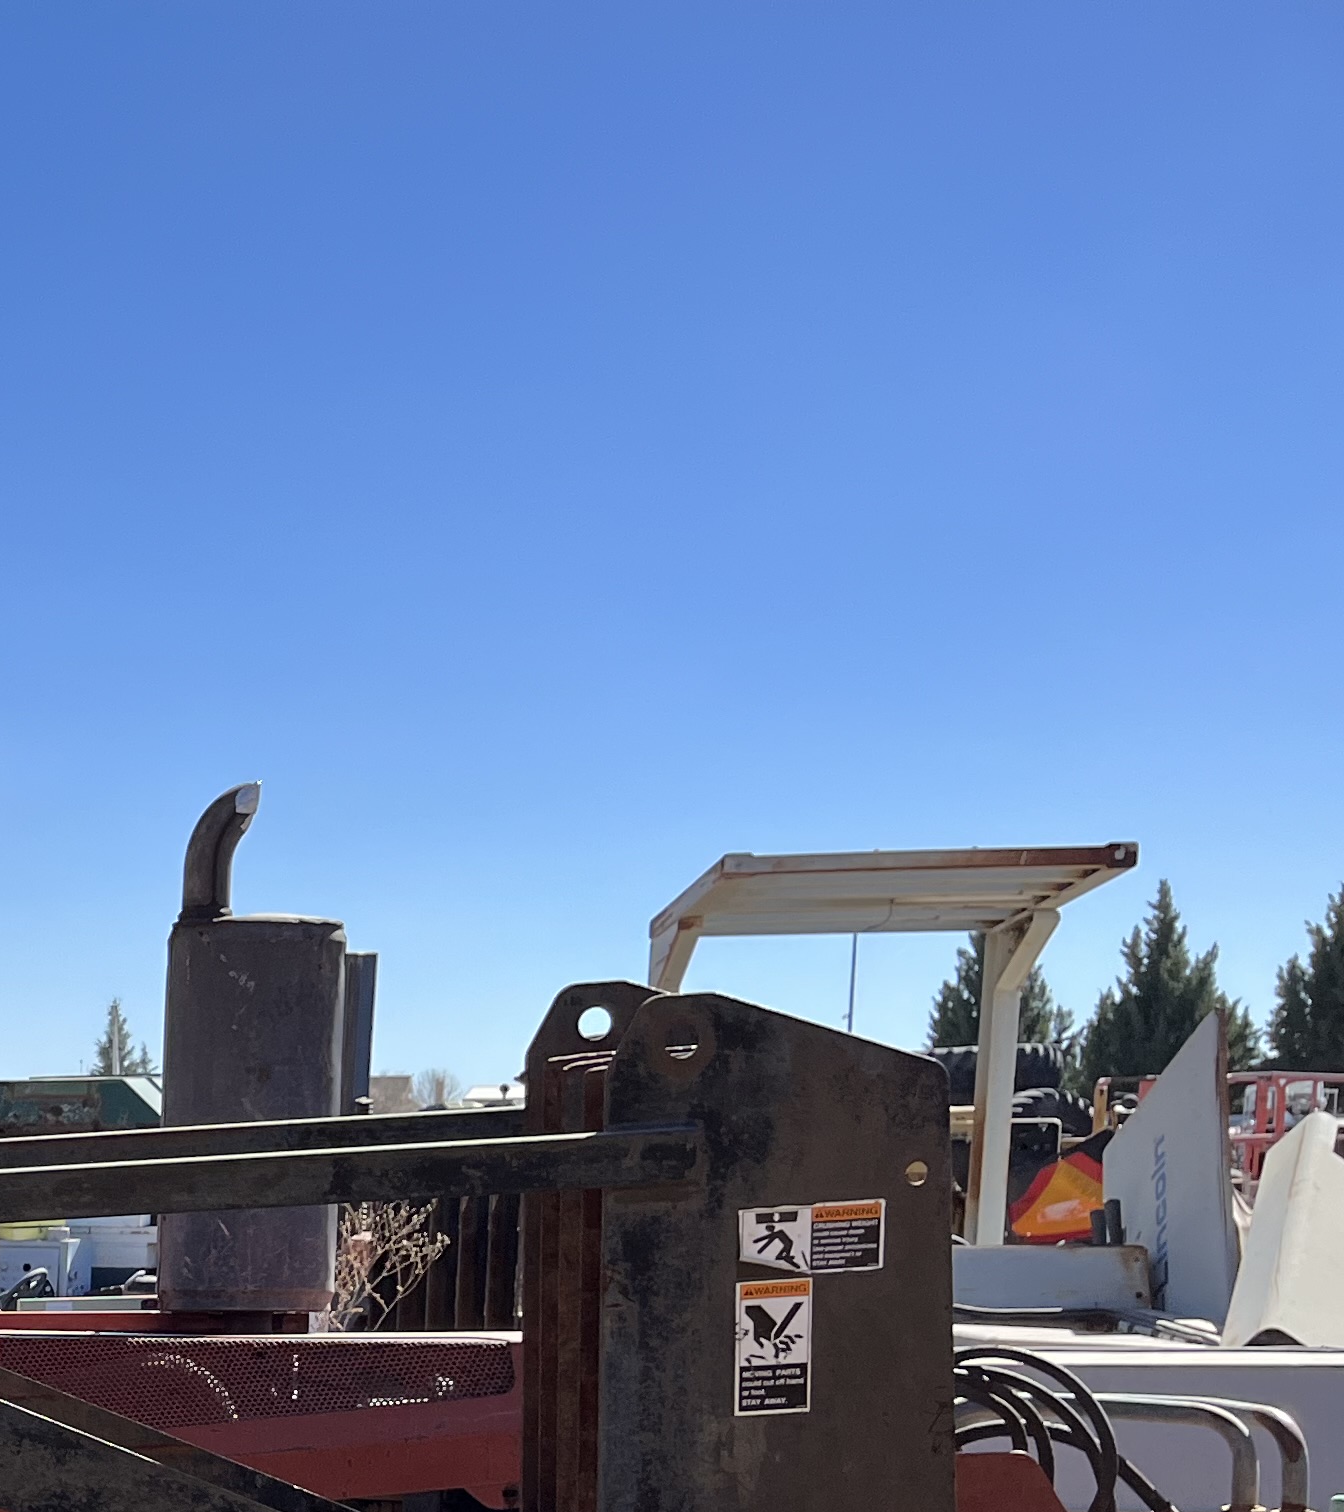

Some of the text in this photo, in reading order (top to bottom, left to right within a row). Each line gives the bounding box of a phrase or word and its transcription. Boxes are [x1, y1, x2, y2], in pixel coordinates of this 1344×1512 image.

[825, 1207, 878, 1218] WARNING
[754, 1284, 806, 1296] WARNING
[775, 1368, 801, 1376] PARTS
